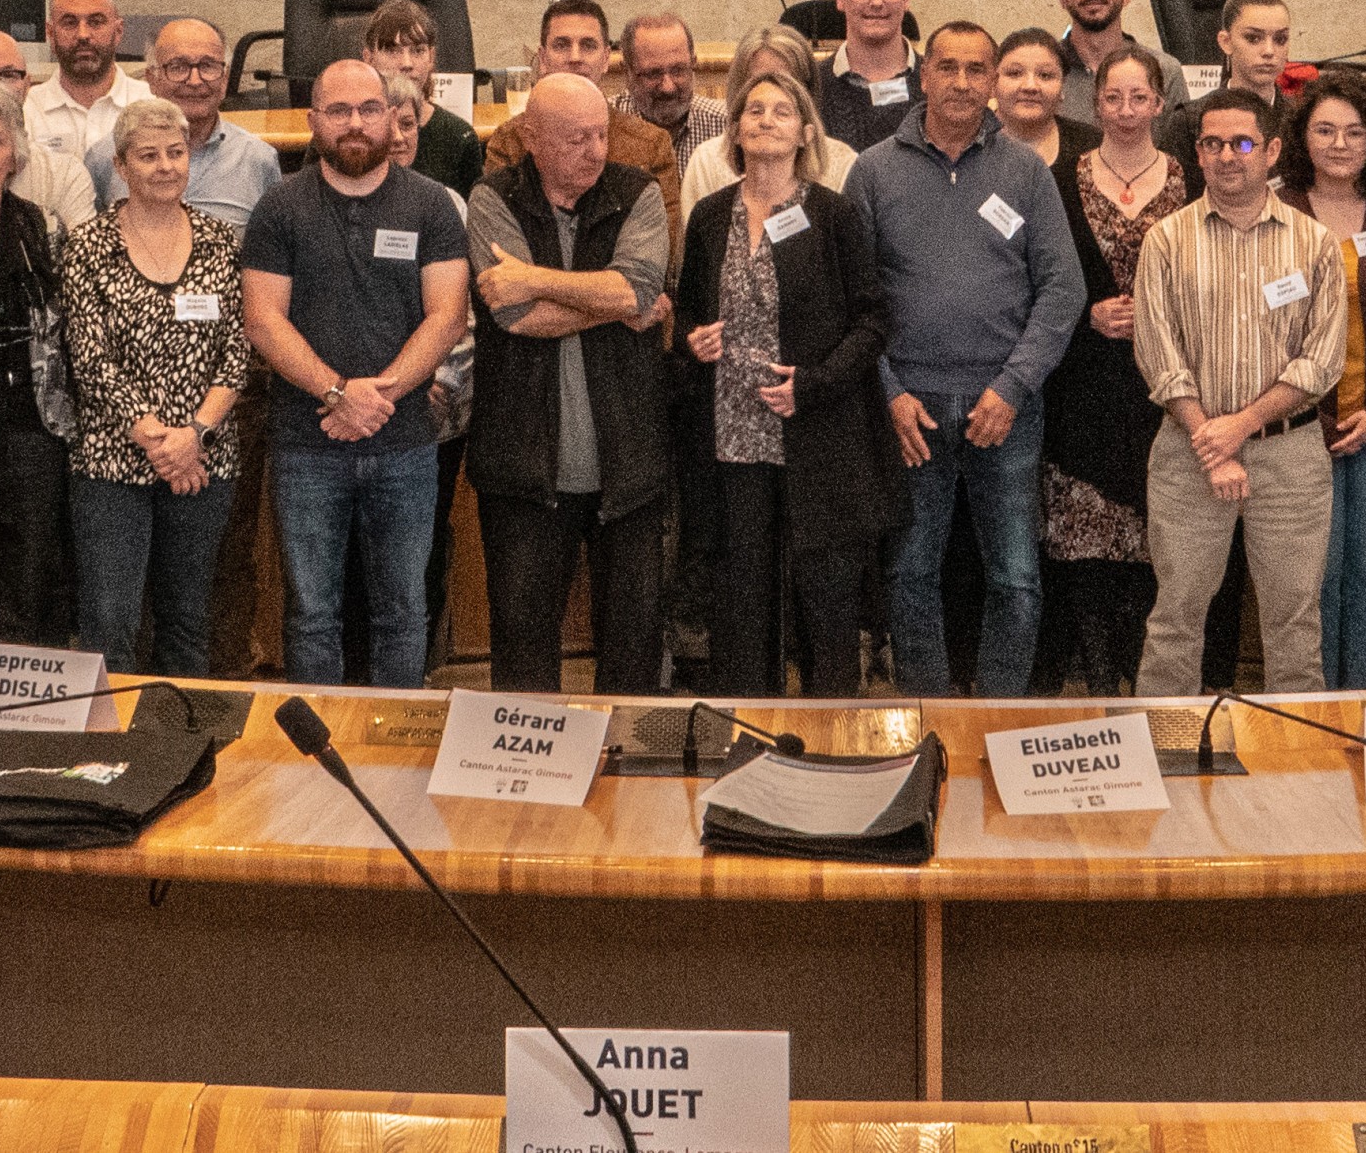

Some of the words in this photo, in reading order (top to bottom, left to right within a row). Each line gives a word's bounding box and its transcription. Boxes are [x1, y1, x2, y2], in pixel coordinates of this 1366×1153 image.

[494, 707, 567, 733] Gérard
[492, 733, 554, 756] AZAM
[1020, 728, 1122, 756] Elisabeth
[459, 759, 494, 771] Canton
[495, 764, 533, 776] Astarac
[536, 768, 573, 780] Gimone
[1032, 754, 1121, 778] DUVEAU
[1024, 788, 1060, 797] Canton
[1063, 784, 1101, 794] Astarac
[1104, 781, 1142, 790] Gimone
[596, 1038, 689, 1070] Anna
[584, 1089, 703, 1119] JOUET
